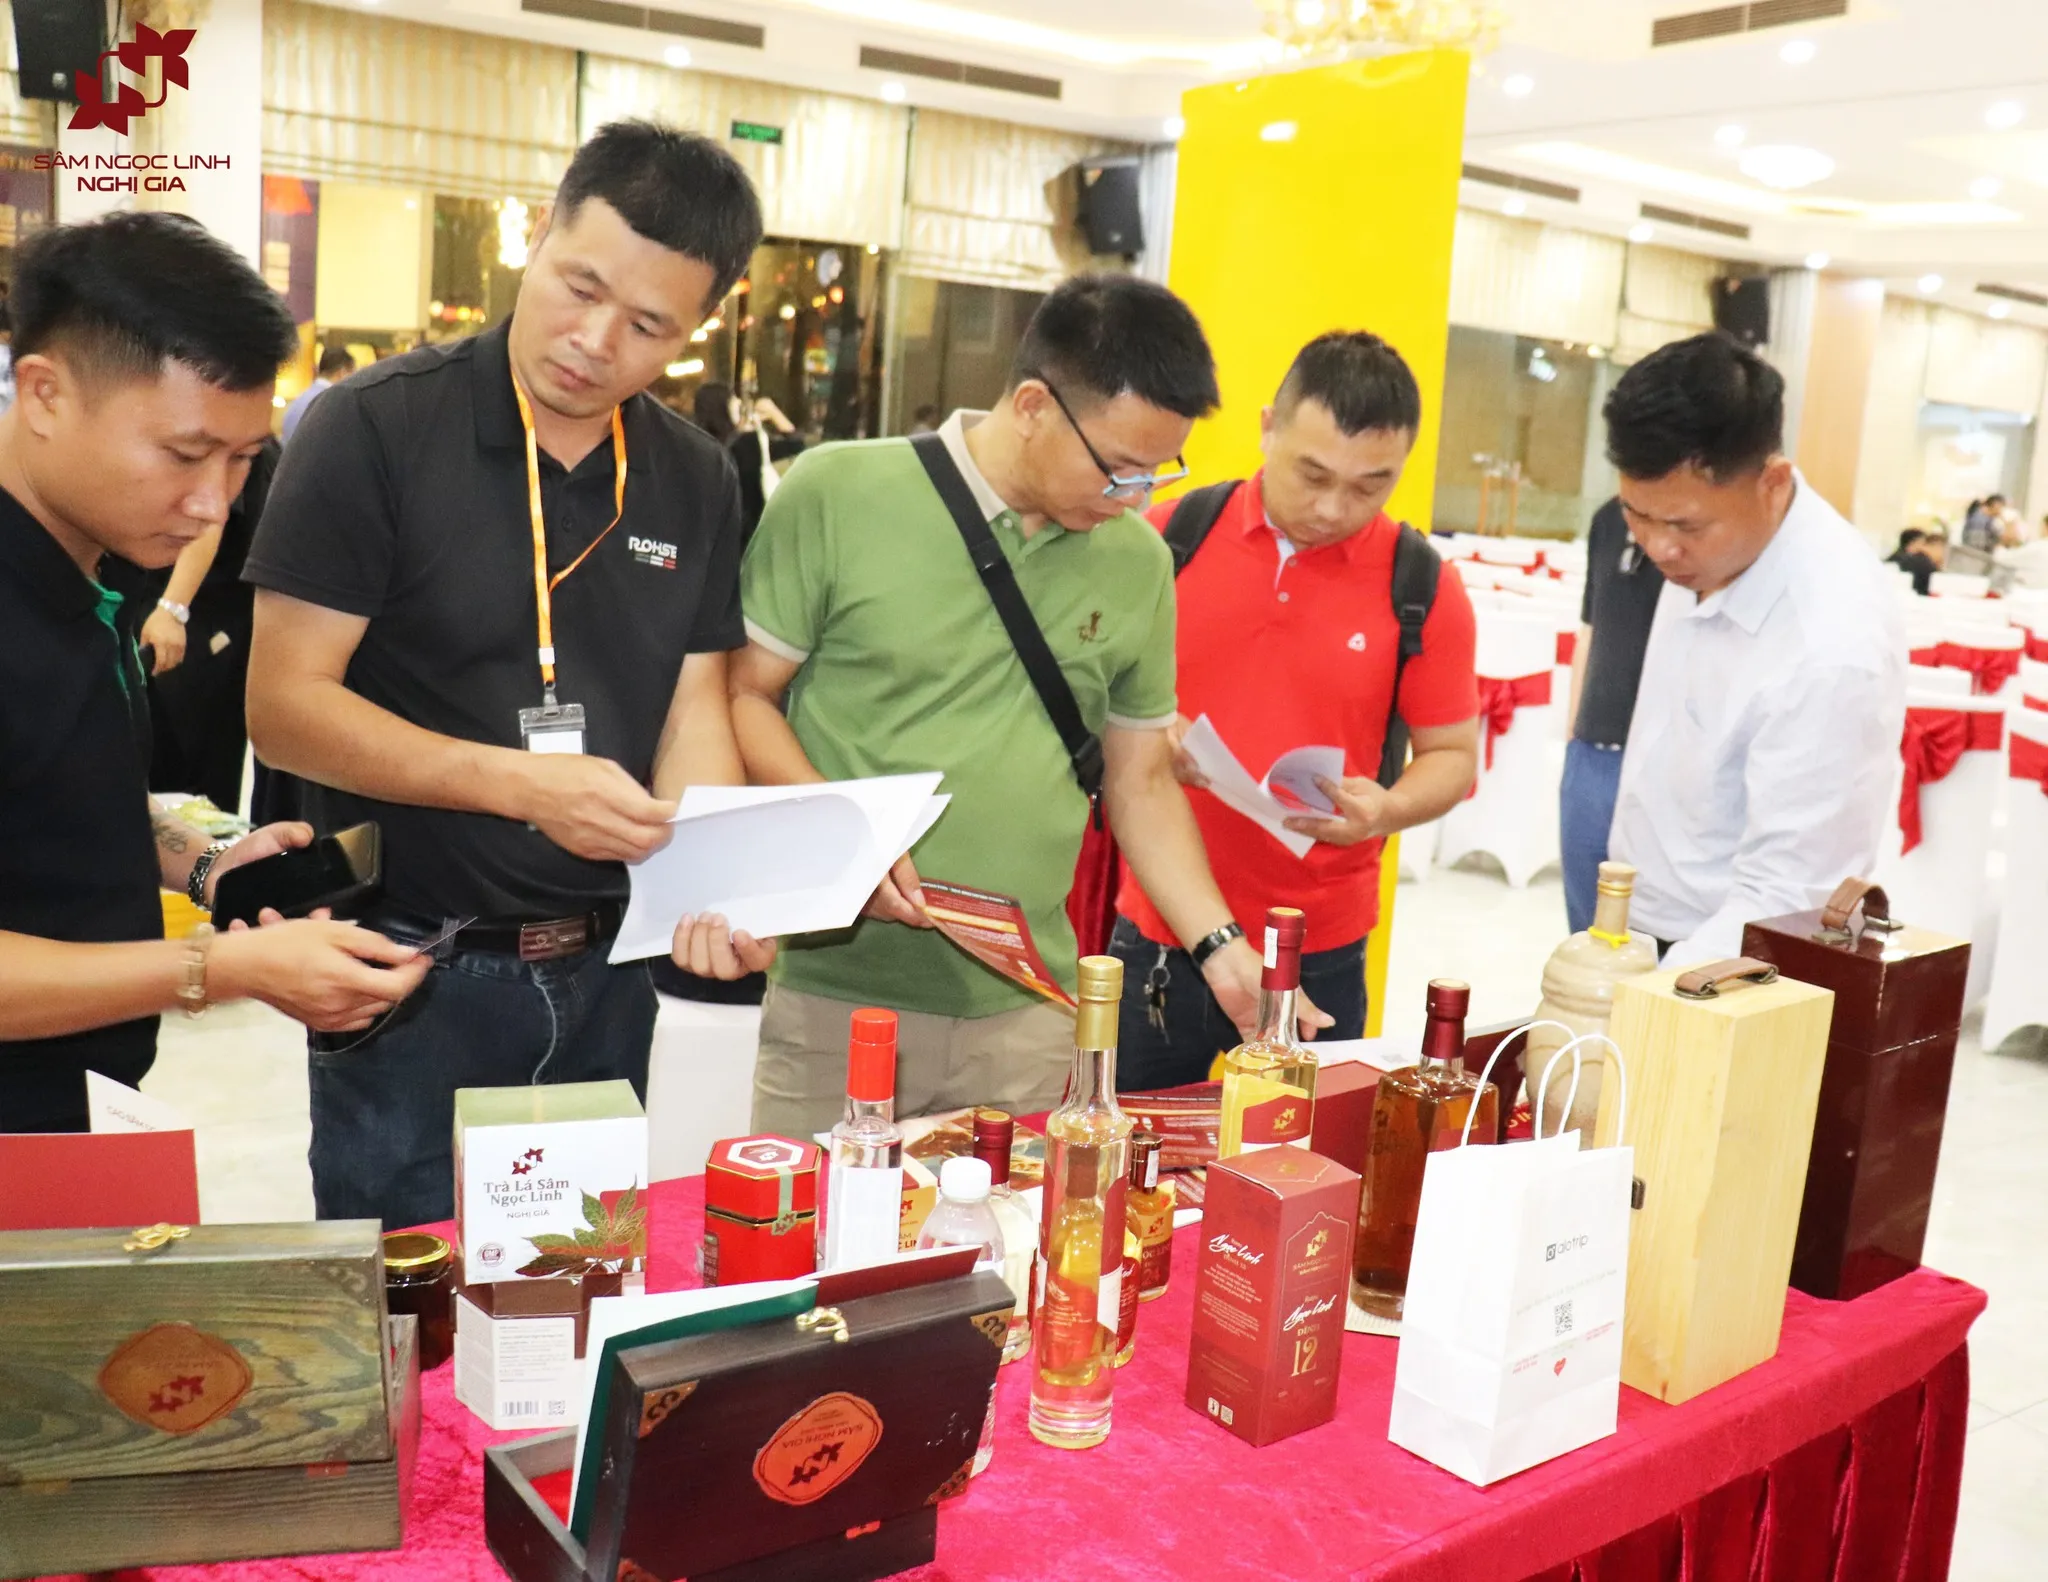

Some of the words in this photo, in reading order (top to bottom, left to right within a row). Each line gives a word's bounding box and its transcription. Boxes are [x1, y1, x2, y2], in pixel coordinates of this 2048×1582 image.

[484, 1179, 510, 1194] Trà
[515, 1178, 533, 1192] Lá
[537, 1177, 570, 1191] Sâm
[490, 1193, 526, 1208] Ngọc
[530, 1189, 563, 1202] Linh
[506, 1211, 532, 1220] NGHỊ
[533, 1208, 550, 1217] GIA
[1556, 1234, 1589, 1255] alotrip
[1290, 1336, 1318, 1377] 12
